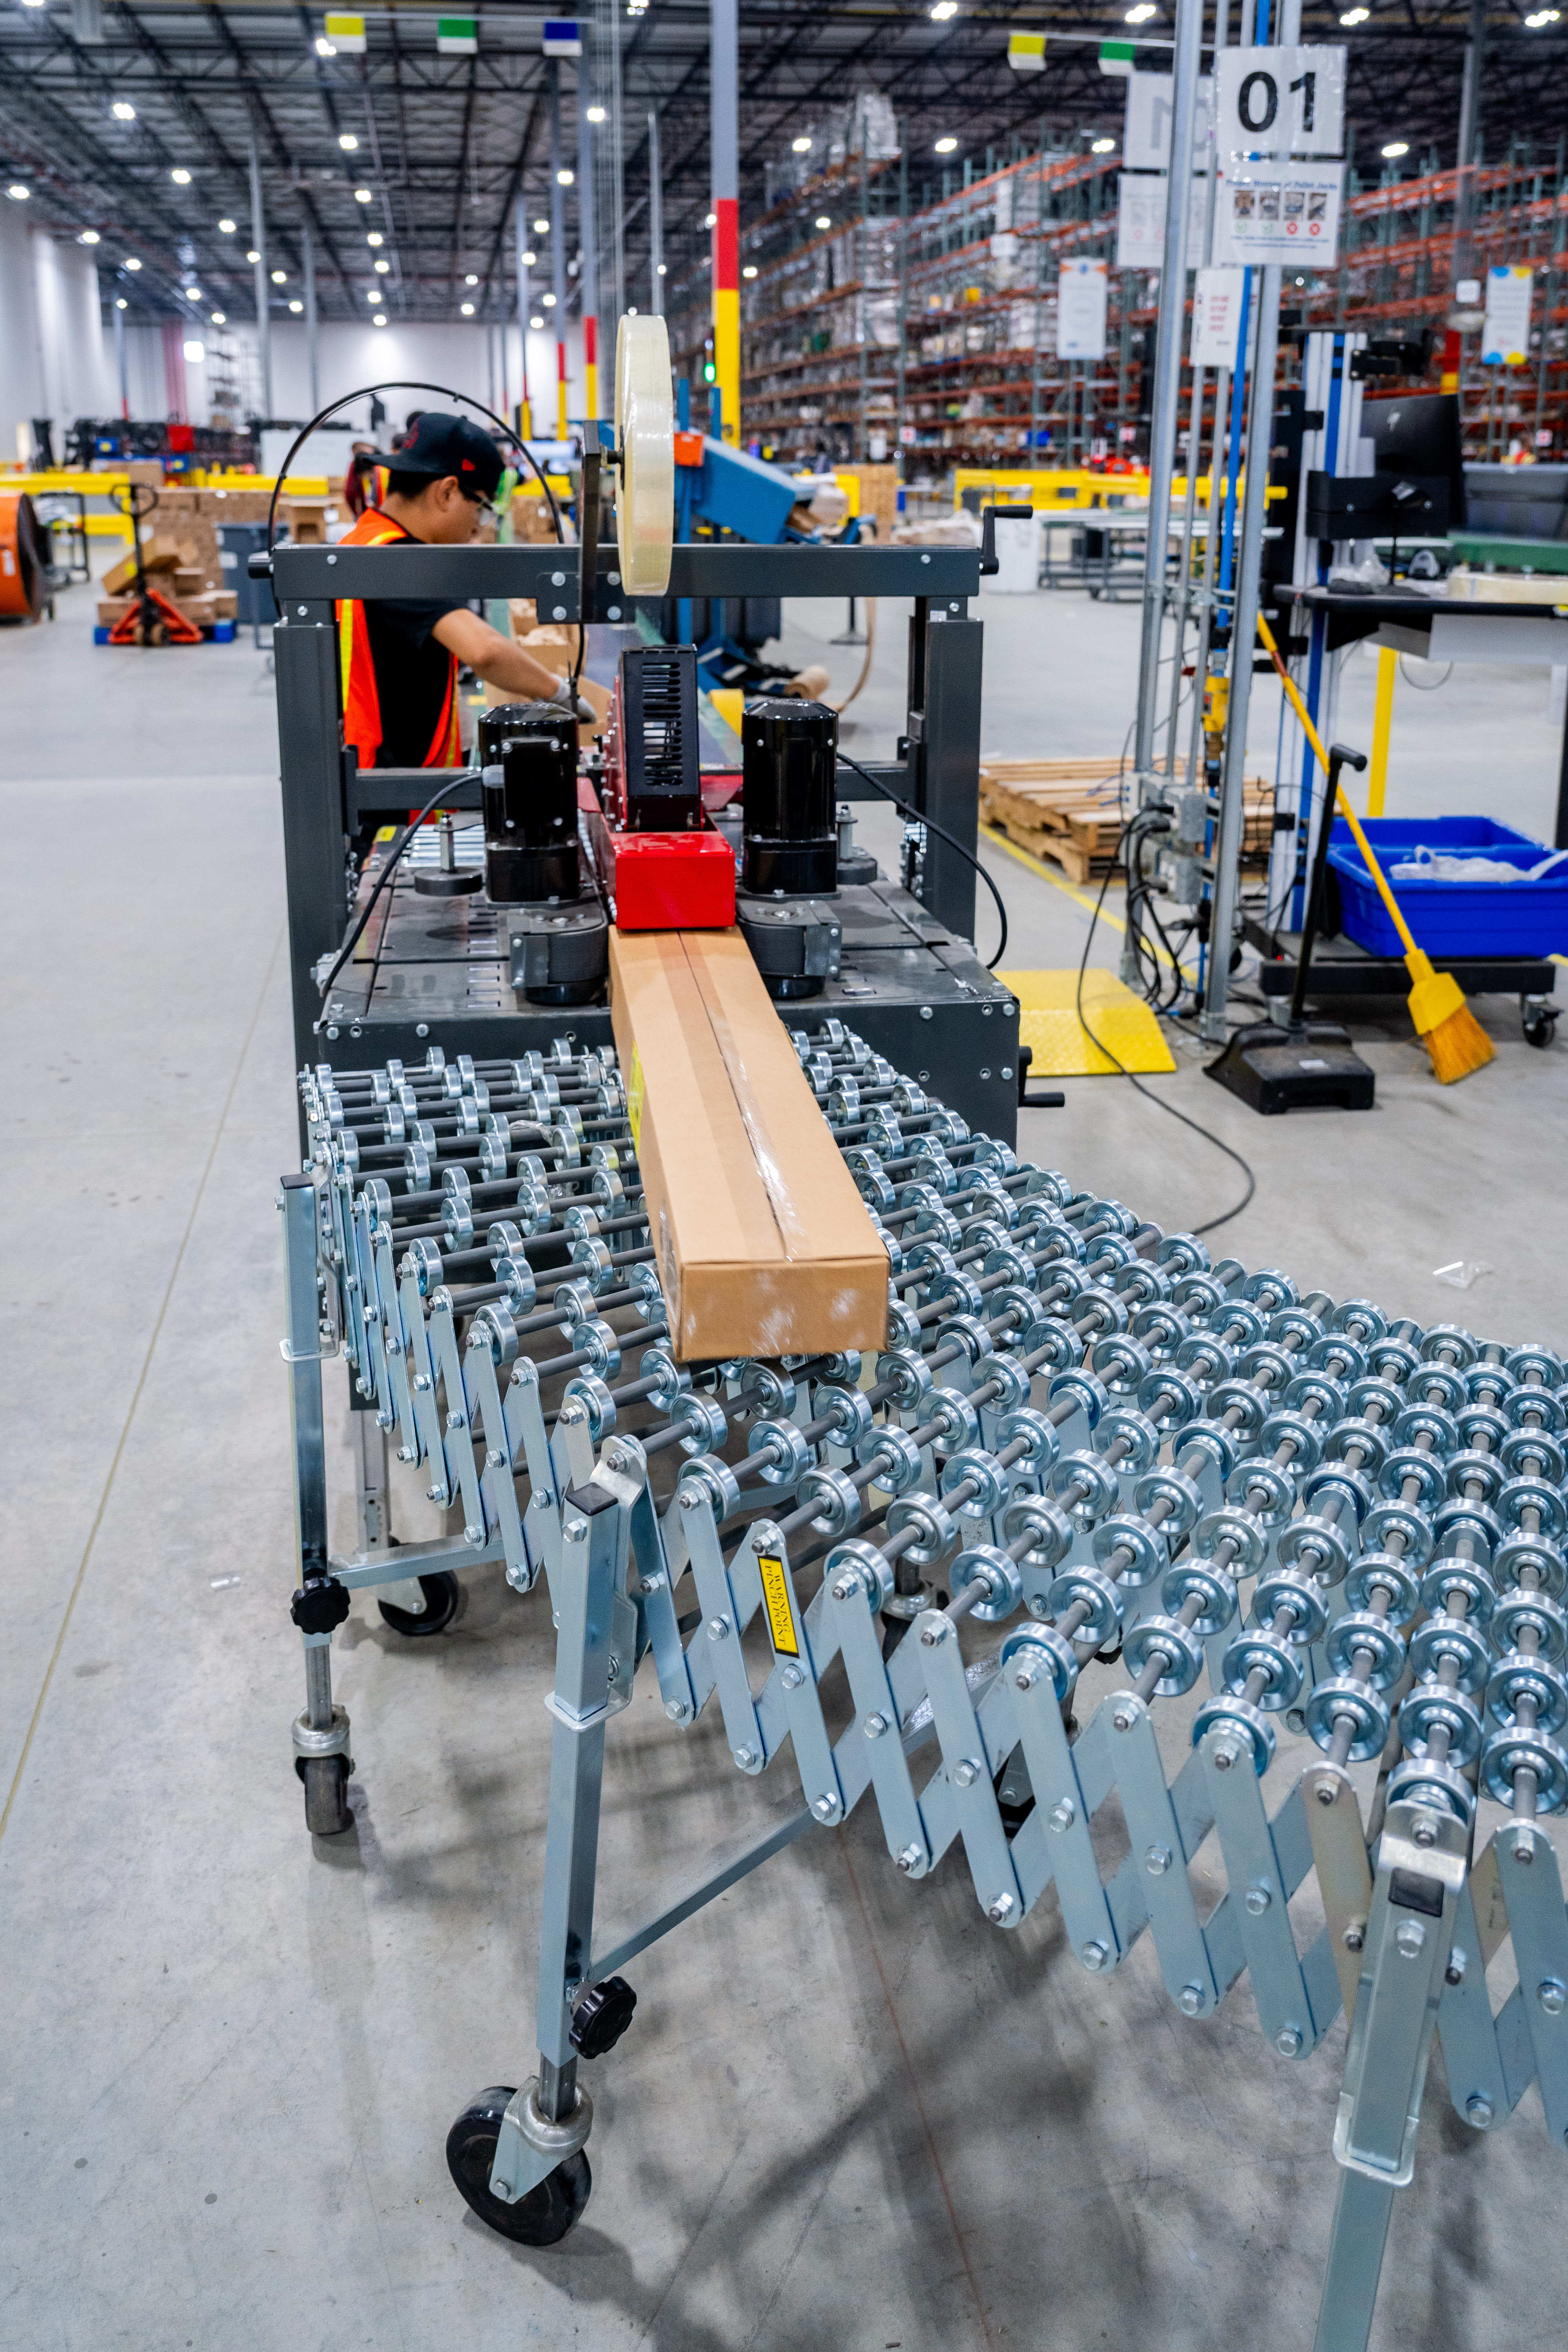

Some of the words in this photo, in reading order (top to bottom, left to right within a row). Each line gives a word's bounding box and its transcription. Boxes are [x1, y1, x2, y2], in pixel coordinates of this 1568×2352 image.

[1238, 71, 1316, 132] 01
[765, 1565, 778, 1604] PINCH
[773, 1608, 786, 1645] POINT
[775, 1575, 790, 1632] WARNING
